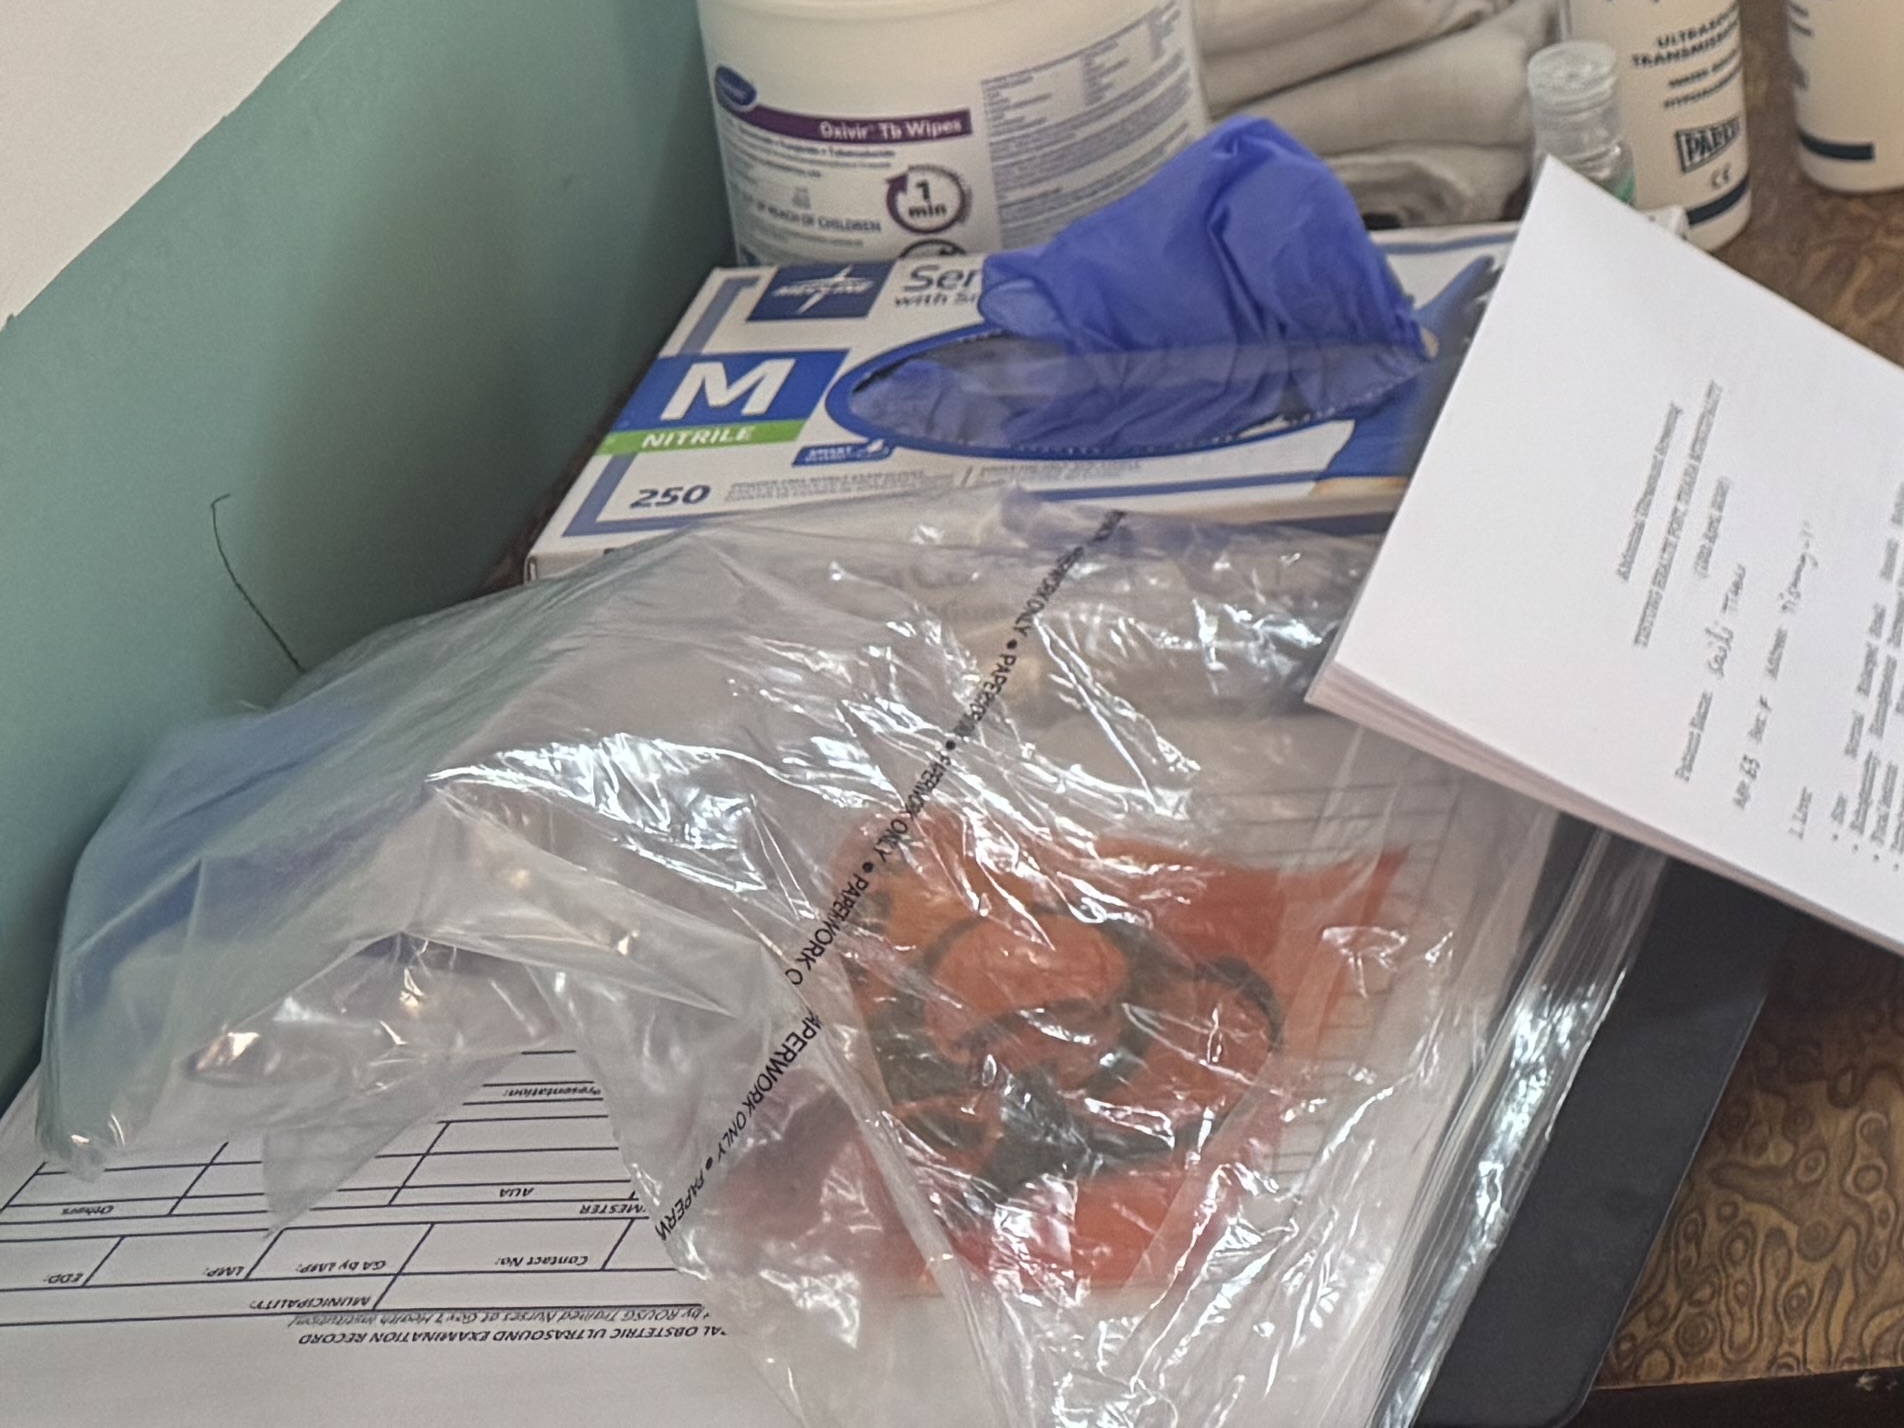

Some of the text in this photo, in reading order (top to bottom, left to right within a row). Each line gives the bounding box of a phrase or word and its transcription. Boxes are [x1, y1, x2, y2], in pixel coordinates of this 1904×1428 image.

[906, 117, 962, 139] Wipes
[908, 179, 948, 219] 1 min
[660, 359, 796, 421] M
[641, 425, 754, 448] NITRILE
[630, 485, 711, 508] 250
[869, 815, 909, 863] ONLY
[793, 870, 870, 973] PAPERWORK
[708, 1008, 825, 1161] APERWORK ONLY
[498, 1186, 534, 1198] AUA
[59, 1204, 114, 1215] Others
[202, 1265, 244, 1276] LMP:
[295, 1257, 386, 1273] GA by LMP:
[494, 1254, 589, 1267] Contact No:
[41, 1271, 84, 1283] EDD:
[502, 1312, 556, 1324] Nurses
[557, 1311, 617, 1323] Trained
[296, 1325, 725, 1345] AL OBSTETRIC ULTRASOUND EXAMINATION RECORD
